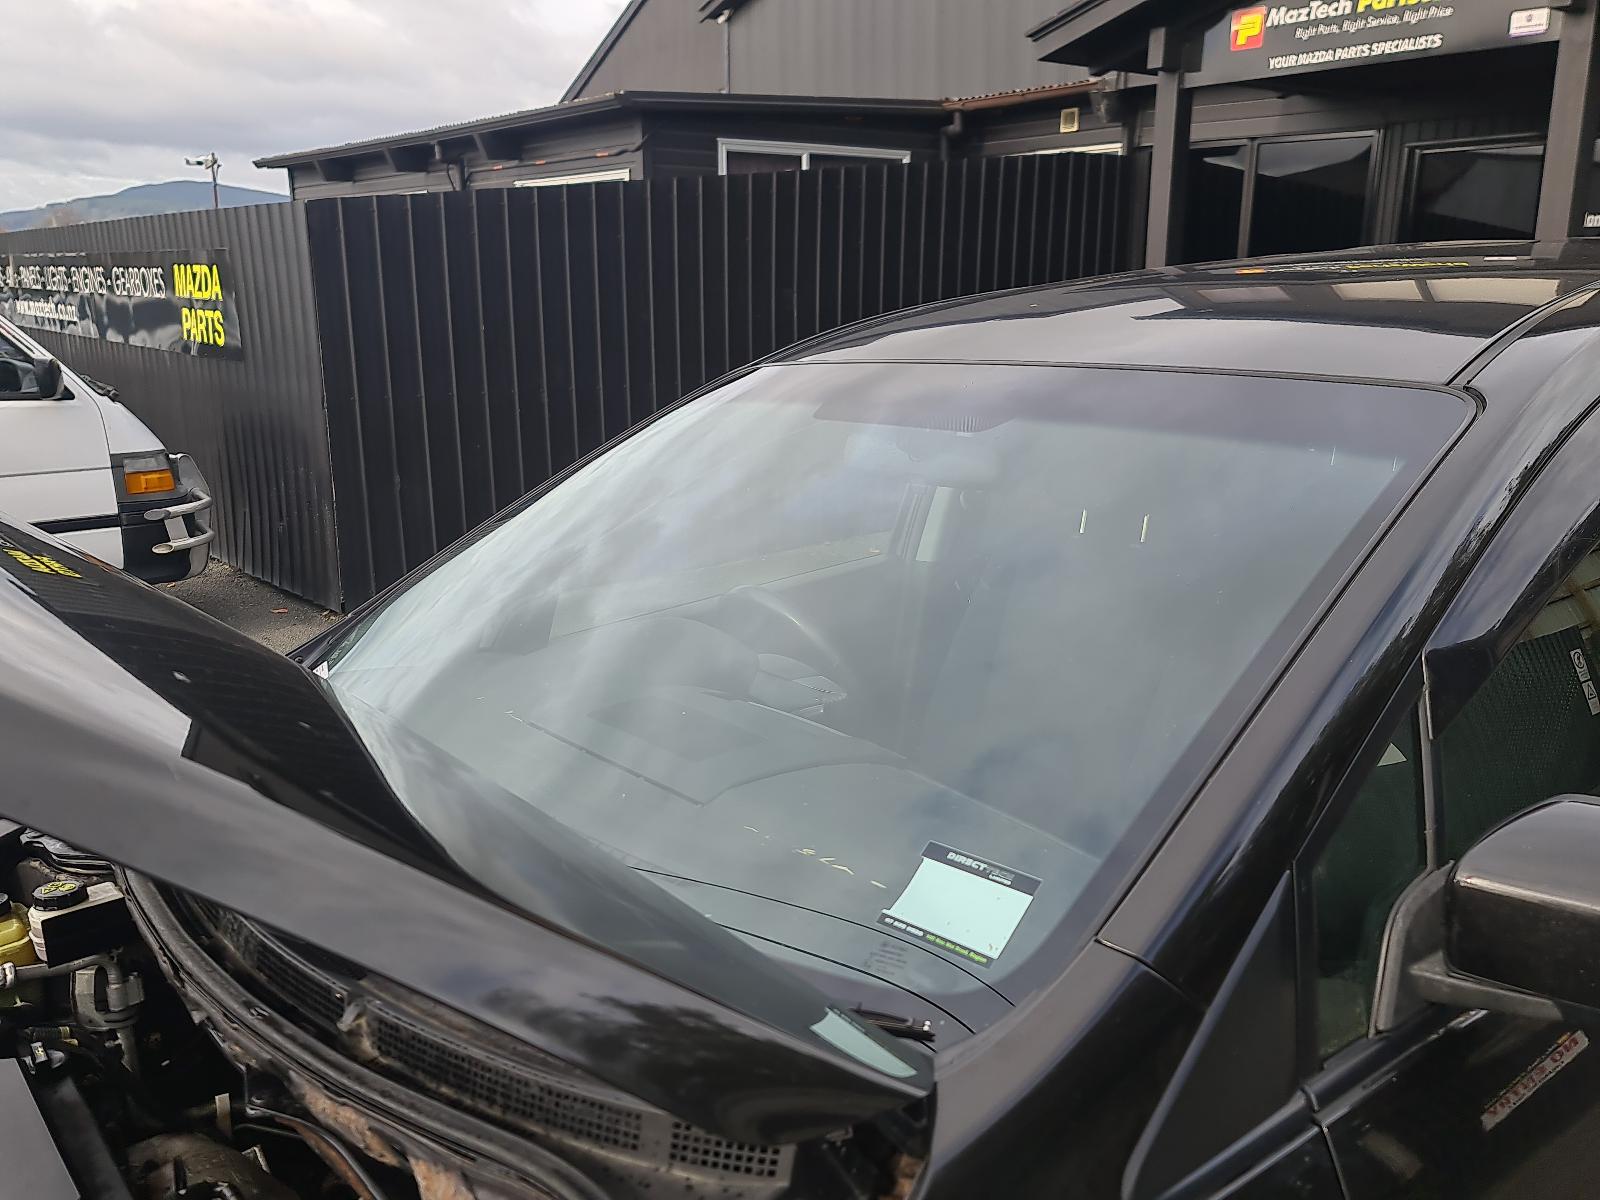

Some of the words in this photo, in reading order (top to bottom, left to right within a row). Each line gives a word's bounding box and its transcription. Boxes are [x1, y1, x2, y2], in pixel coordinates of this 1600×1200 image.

[1265, 0, 1353, 28] MazTech
[1294, 25, 1318, 41] Right
[1342, 17, 1367, 33] Right
[1402, 7, 1429, 24] Right
[1427, 5, 1455, 19] Price
[1268, 54, 1298, 70] YOUR
[1296, 49, 1335, 66] MAZDA
[1334, 43, 1371, 61] PARTS
[1370, 33, 1444, 56] SPECIALISTS
[111, 266, 167, 299] GEARBOXES
[172, 263, 223, 301] MAZDA
[181, 307, 225, 347] PARTS
[946, 851, 988, 871] DIRECT
